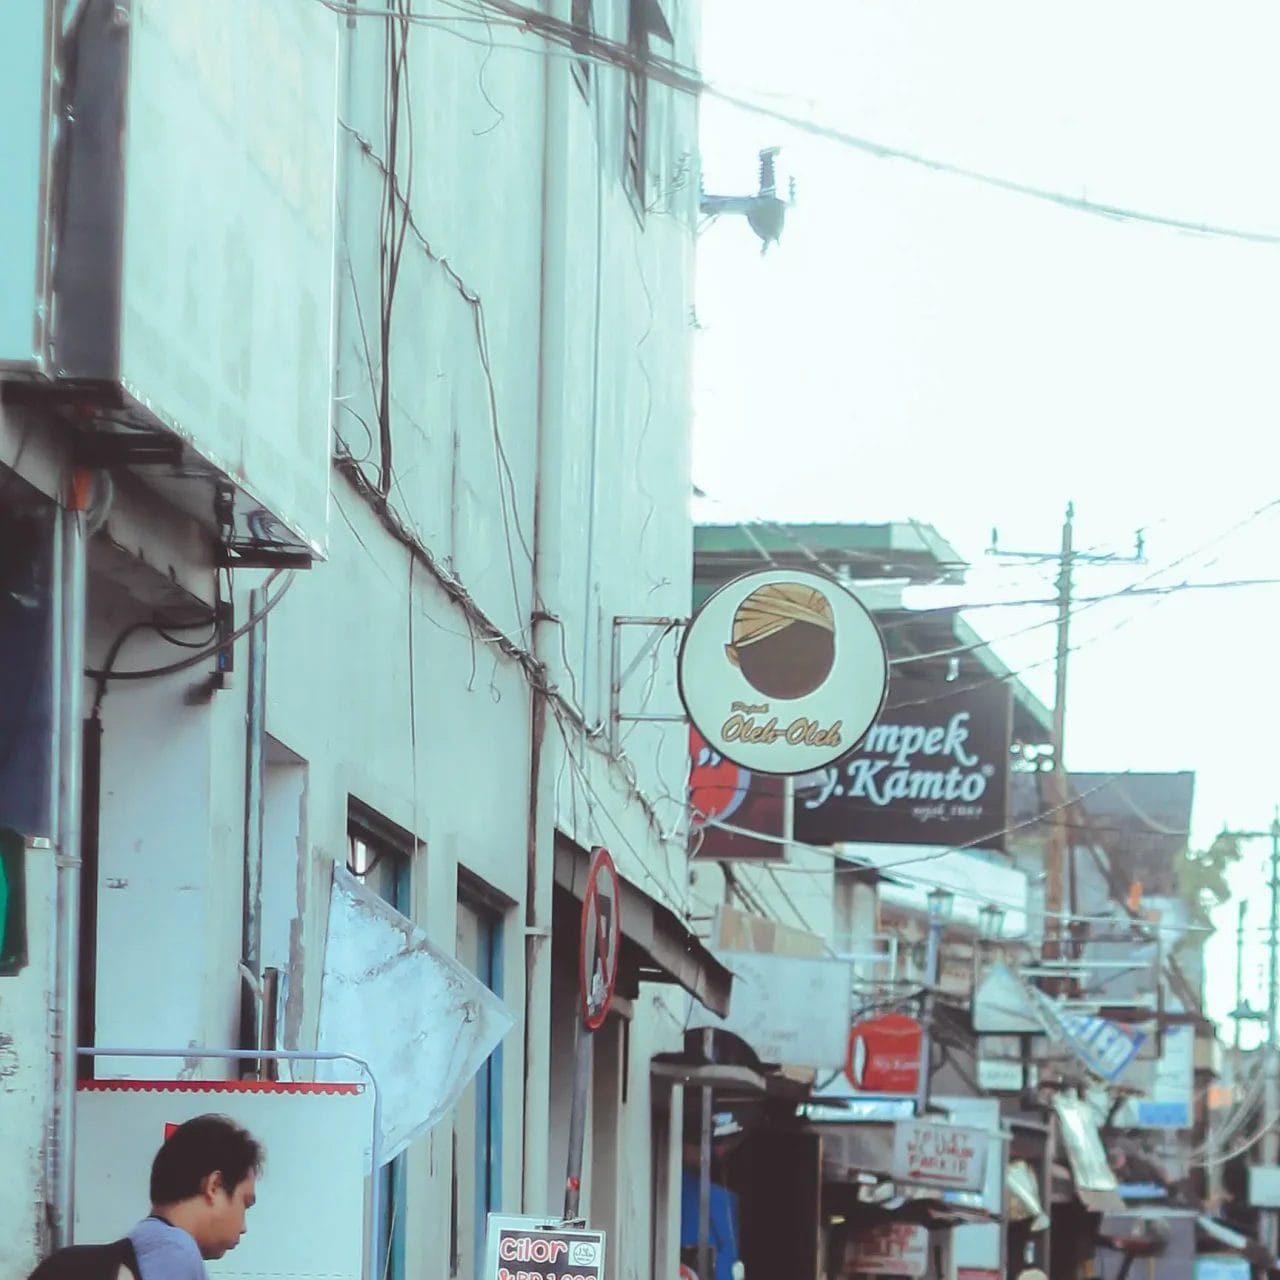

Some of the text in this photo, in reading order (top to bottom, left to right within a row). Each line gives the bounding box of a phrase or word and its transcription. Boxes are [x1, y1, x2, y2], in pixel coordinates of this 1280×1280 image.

[721, 714, 842, 747] Oleh-Oleh
[864, 712, 979, 767] mpek
[804, 759, 986, 809] y.Kamto
[500, 1237, 567, 1263] Cilor
